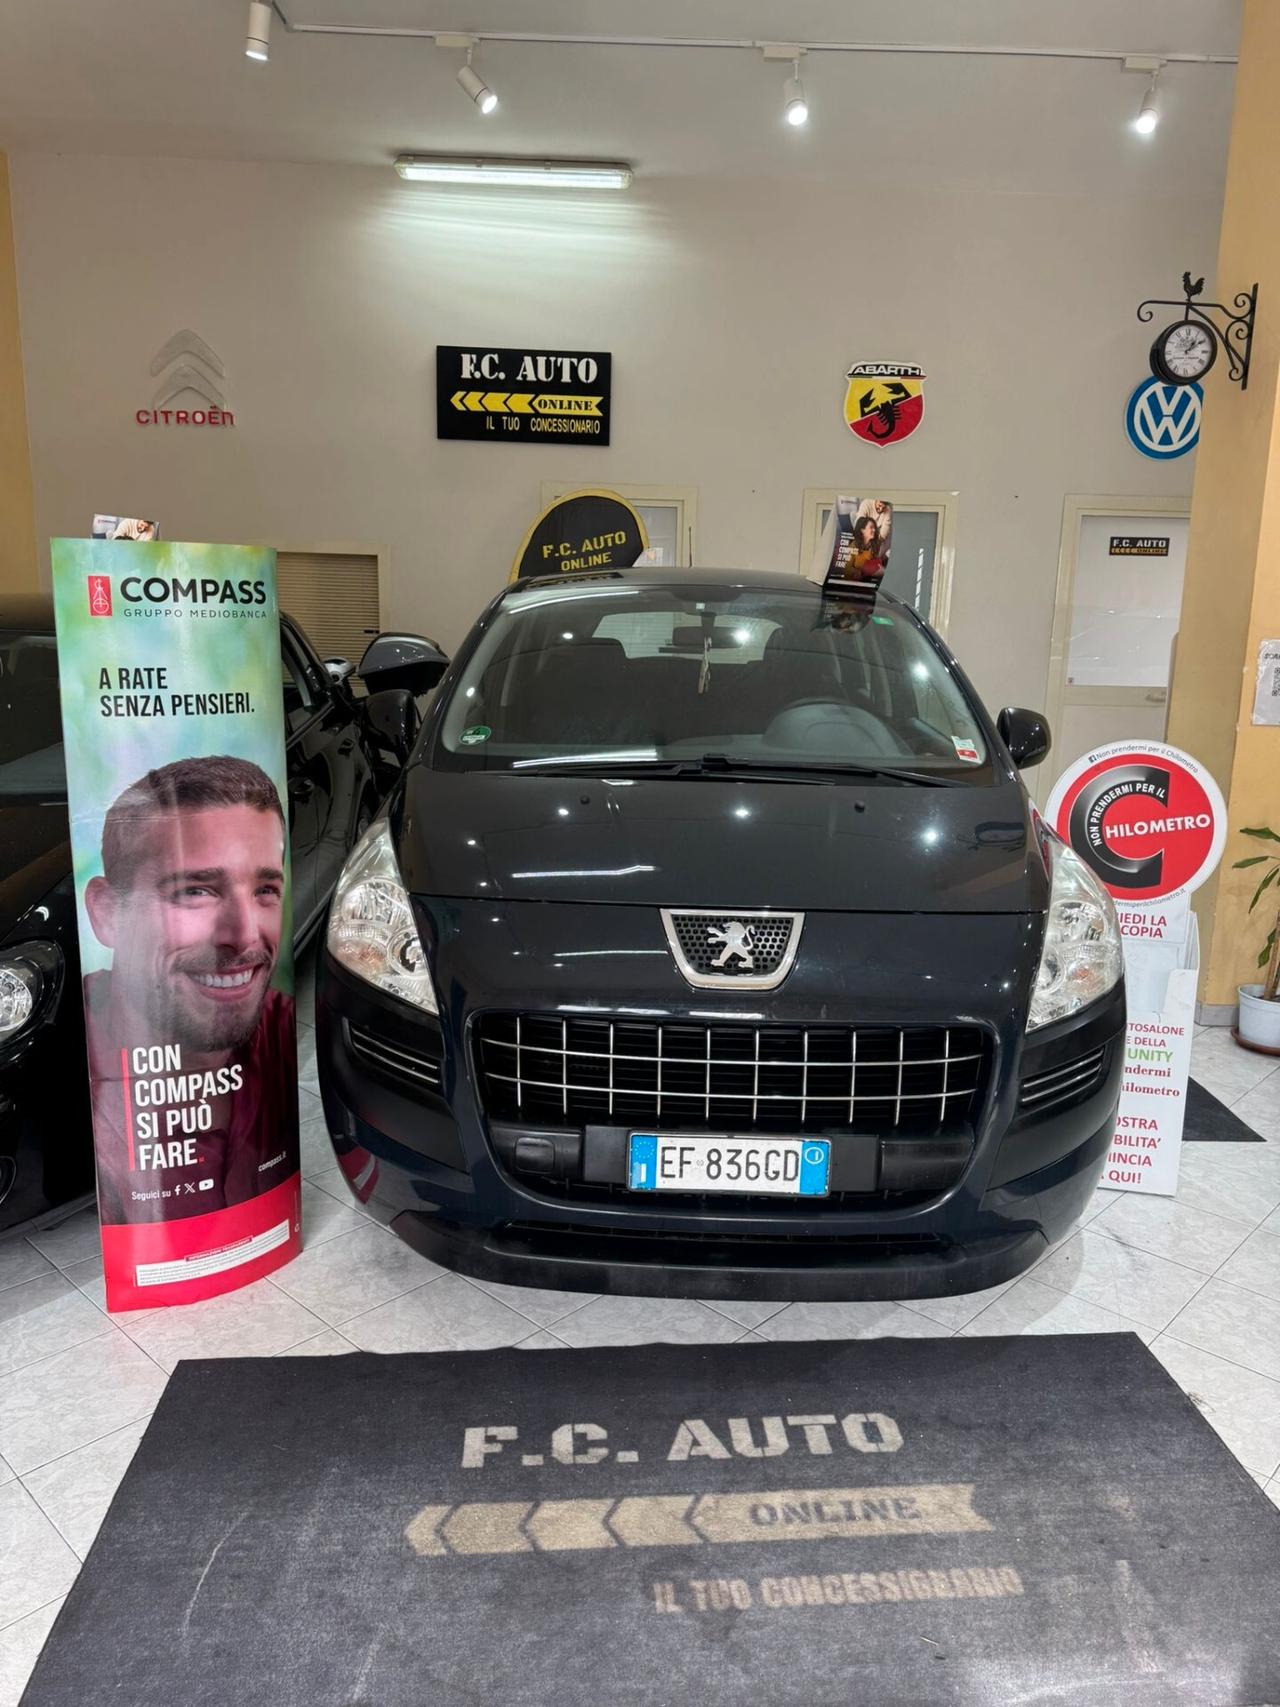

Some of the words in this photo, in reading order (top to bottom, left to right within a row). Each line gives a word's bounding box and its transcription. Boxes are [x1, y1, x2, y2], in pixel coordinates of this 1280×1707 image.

[460, 353, 506, 380] F.C.
[516, 355, 598, 384] AUTO
[853, 365, 920, 375] ABARTH
[538, 398, 593, 412] ONLINE
[486, 416, 495, 430] IL
[502, 416, 520, 431] TUO
[531, 418, 600, 434] CONCESSIONARIO
[542, 543, 577, 558] F.C.
[581, 531, 626, 552] AUTO
[1113, 539, 1132, 547] F.C.
[1136, 539, 1166, 547] AUTO
[561, 551, 612, 571] ONLINE
[120, 577, 266, 604] COMPASS
[124, 608, 183, 618] GRUPPO
[190, 609, 267, 619] MEDIOBANCA
[99, 667, 111, 690] A
[118, 667, 168, 690] RATE
[100, 694, 165, 717] SENZA
[171, 692, 255, 716] PENSIERI.
[1096, 750, 1111, 760] Non
[1135, 783, 1155, 794] PER
[1156, 787, 1167, 798] IL
[1090, 783, 1133, 823] PRENDERMI
[1089, 824, 1102, 846] NON
[1117, 912, 1146, 925] IEDI
[1150, 915, 1167, 927] LA
[1120, 925, 1163, 938] COPIA
[1126, 1022, 1184, 1036] TOSALONE
[1134, 1036, 1166, 1047] DELLA
[132, 1044, 181, 1074] CON
[1128, 1048, 1173, 1062] UNITY
[134, 1064, 243, 1107] COMPASS
[136, 1108, 158, 1139] SI
[166, 1098, 212, 1136] PUÒ
[138, 1138, 204, 1171] FARE.
[258, 1151, 287, 1172] compass.it
[1108, 1152, 1152, 1167] INCIA
[1108, 1170, 1142, 1184] QUI!
[131, 1188, 160, 1201] Seguici
[162, 1190, 171, 1198] su
[461, 1423, 639, 1469] F.C.
[667, 1412, 905, 1461] AUTO
[750, 1496, 922, 1527] ONLINE
[653, 1581, 683, 1614] IL
[689, 1577, 752, 1611] TUO
